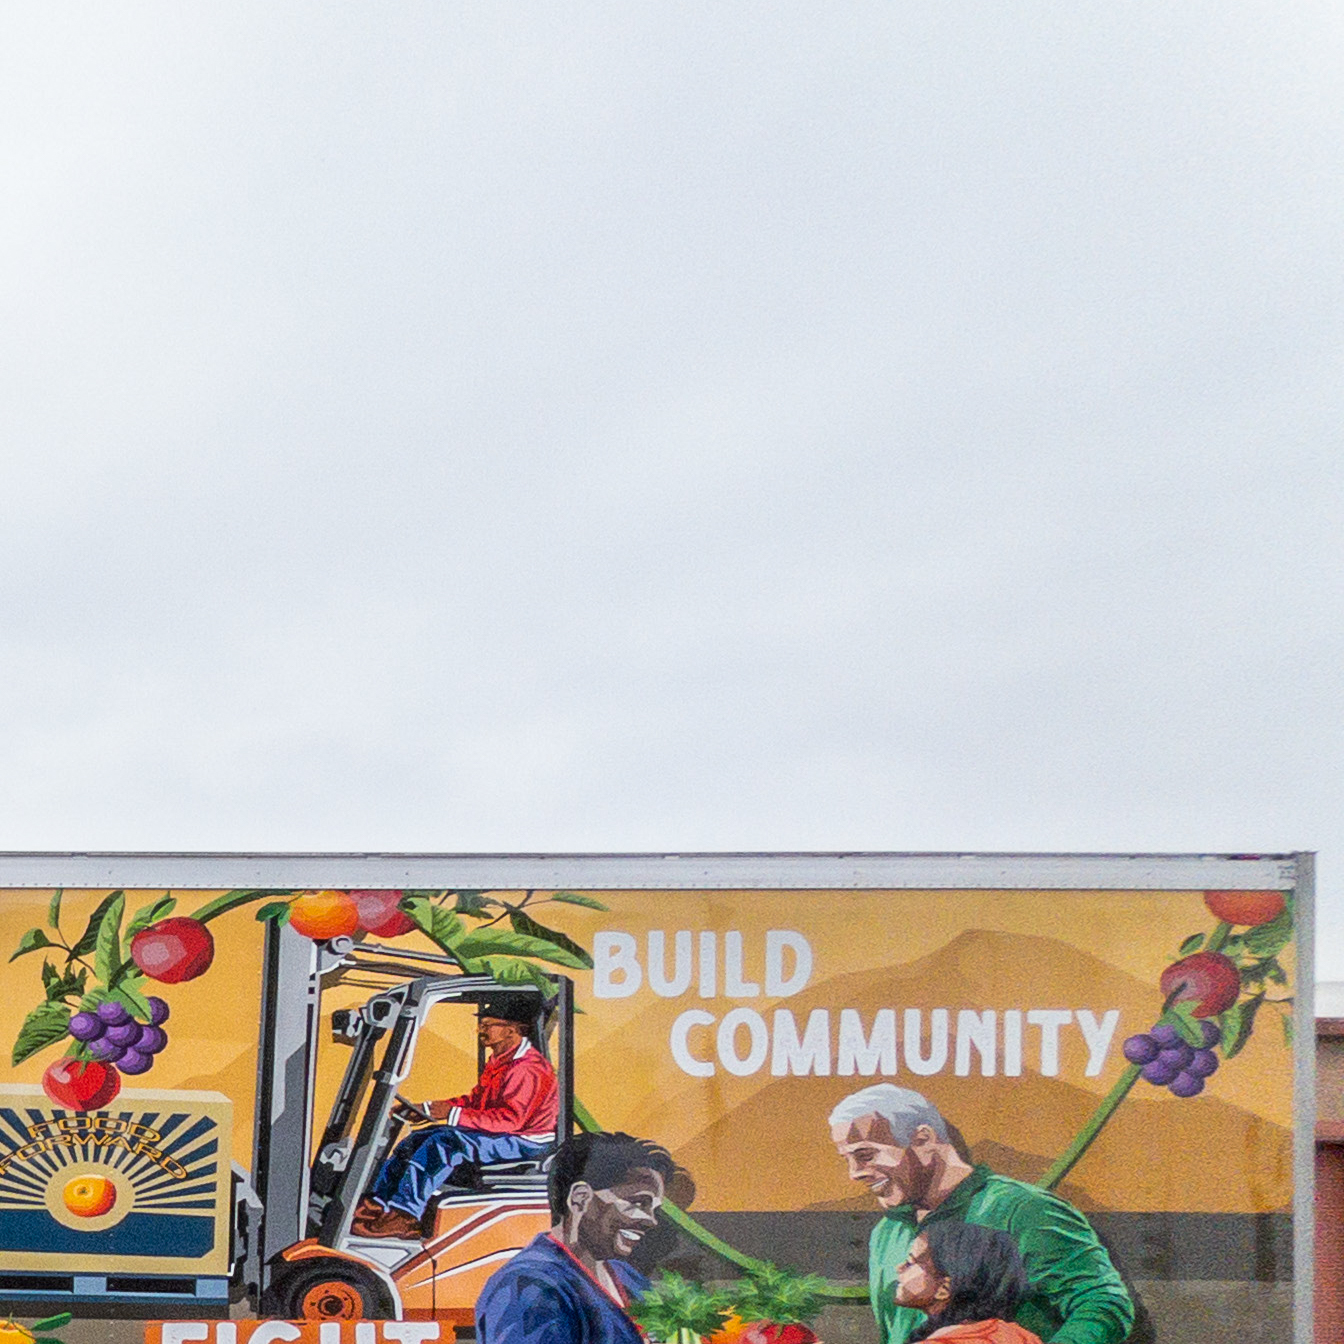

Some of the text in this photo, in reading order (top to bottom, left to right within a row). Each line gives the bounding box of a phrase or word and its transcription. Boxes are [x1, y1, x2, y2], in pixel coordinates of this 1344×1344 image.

[592, 929, 813, 998] BUILD
[670, 1008, 1120, 1077] COMMUNITY
[27, 1116, 161, 1142] FOOD
